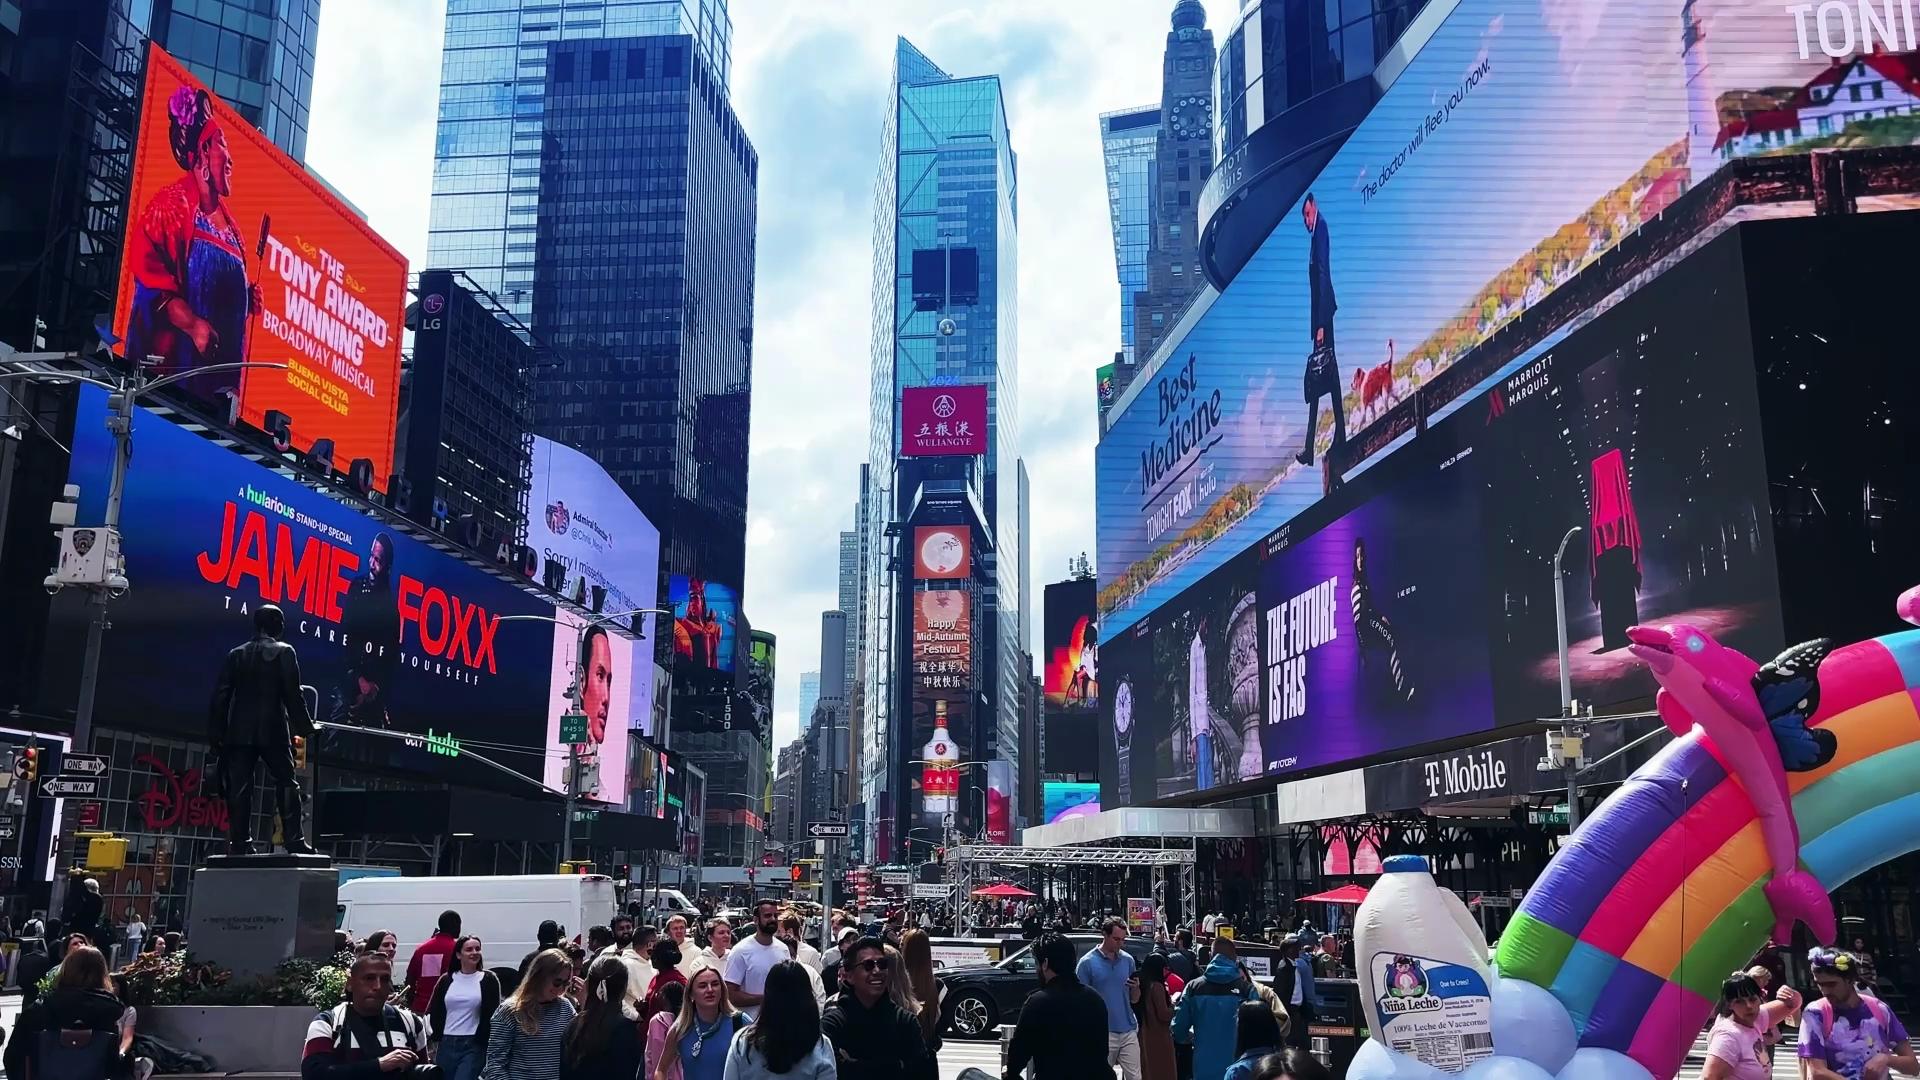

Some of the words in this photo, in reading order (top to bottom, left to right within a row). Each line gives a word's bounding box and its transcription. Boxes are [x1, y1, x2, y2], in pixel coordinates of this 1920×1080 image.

[1361, 182, 1377, 205] The
[1379, 148, 1407, 187] doctor
[1408, 124, 1423, 154] will
[1425, 110, 1443, 138] flee
[1444, 86, 1463, 122] you
[1465, 58, 1491, 94] now.
[266, 234, 322, 299] TONY
[319, 248, 345, 284] THE
[285, 286, 364, 366] WINNING
[423, 318, 441, 330] LG
[262, 309, 331, 368] BROADWAY
[331, 357, 375, 398] MUSICAL
[288, 357, 321, 386] BUENA
[321, 375, 349, 404] VISTA
[1157, 351, 1197, 427] Best
[1508, 354, 1553, 392] MARRIOTT
[1509, 374, 1549, 407] MARQUIS
[287, 371, 320, 400] SOCIAL
[320, 392, 349, 417] CLUB
[913, 421, 974, 438] 五粮液
[917, 438, 972, 447] WULIANGYE
[1141, 388, 1222, 496] Medicine
[1199, 475, 1216, 502] hulu
[238, 487, 245, 498] A
[246, 484, 295, 519] hularious
[296, 512, 327, 534] STAND-UP
[328, 526, 353, 545] SPECIAL
[1147, 500, 1173, 545] TONIGHT
[1173, 482, 1192, 524] FOX
[196, 500, 360, 624] JAMIE
[543, 547, 573, 572] Sorry
[397, 574, 500, 675] FOXX
[917, 632, 967, 641] Mid-Autumn
[927, 619, 957, 630] Happy
[1267, 601, 1288, 666] THE
[1289, 576, 1338, 657] FUTURE
[300, 620, 348, 646] CARE
[365, 641, 384, 657] OF
[400, 652, 479, 686] YOURSELF
[920, 661, 965, 673] 祝全球华人
[924, 644, 960, 654] Festival
[924, 675, 960, 688] 中秋快乐
[1268, 664, 1281, 724] IS
[427, 728, 460, 758] hulu
[67, 761, 83, 769] ONE
[88, 761, 102, 772] WAY
[1442, 751, 1507, 796] Mobile
[48, 782, 66, 791] ONE
[72, 782, 92, 791] WAY
[1538, 813, 1546, 823] W
[1549, 813, 1559, 823] 46
[1384, 1000, 1406, 1013] Niña
[1407, 997, 1439, 1011] Leche
[1414, 1023, 1436, 1032] Leche
[1439, 1021, 1447, 1030] de
